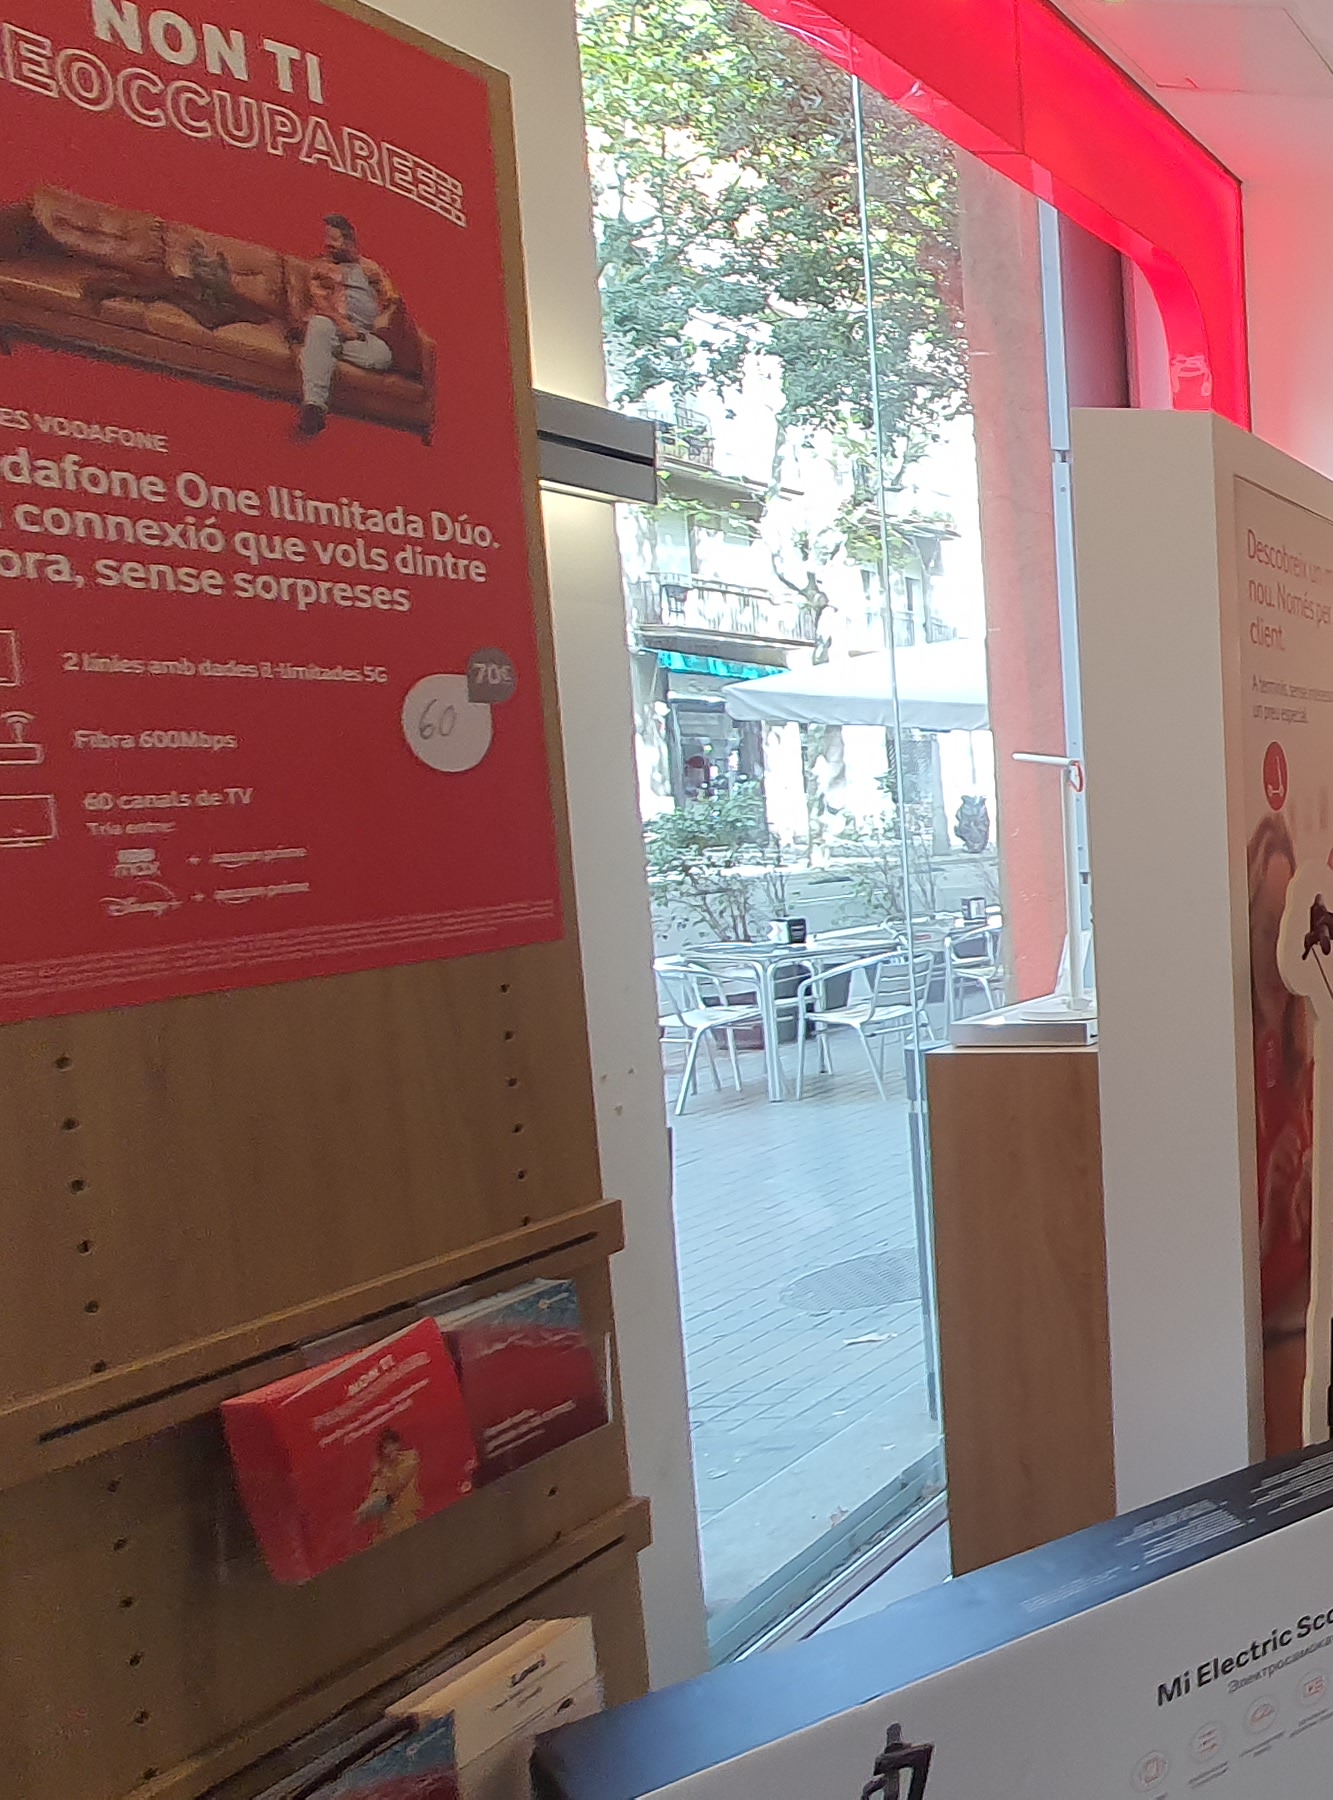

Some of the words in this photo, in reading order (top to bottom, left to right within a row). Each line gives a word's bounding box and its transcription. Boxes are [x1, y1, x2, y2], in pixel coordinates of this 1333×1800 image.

[92, 0, 249, 82] NON
[262, 38, 324, 104] TI
[34, 413, 169, 454] VODAFONE
[176, 472, 261, 517] One
[431, 510, 501, 550] Dúo.
[14, 503, 227, 553] connexió
[234, 530, 306, 566] que
[313, 537, 389, 572] vols
[394, 545, 487, 582] dintre
[95, 558, 225, 598] sense
[233, 571, 412, 612] sorpreses
[63, 652, 80, 671] 2
[148, 659, 196, 676] amb
[198, 661, 259, 678] dades
[362, 666, 389, 684] 5G
[74, 730, 136, 749] Fibra
[138, 731, 239, 750] 600Mbps
[418, 698, 458, 740] 60
[83, 792, 114, 811] 60
[117, 790, 192, 810] canals
[194, 789, 222, 806] de
[222, 787, 254, 805] TV
[1156, 1672, 1192, 1706] Mi
[1196, 1629, 1293, 1690] Electric
